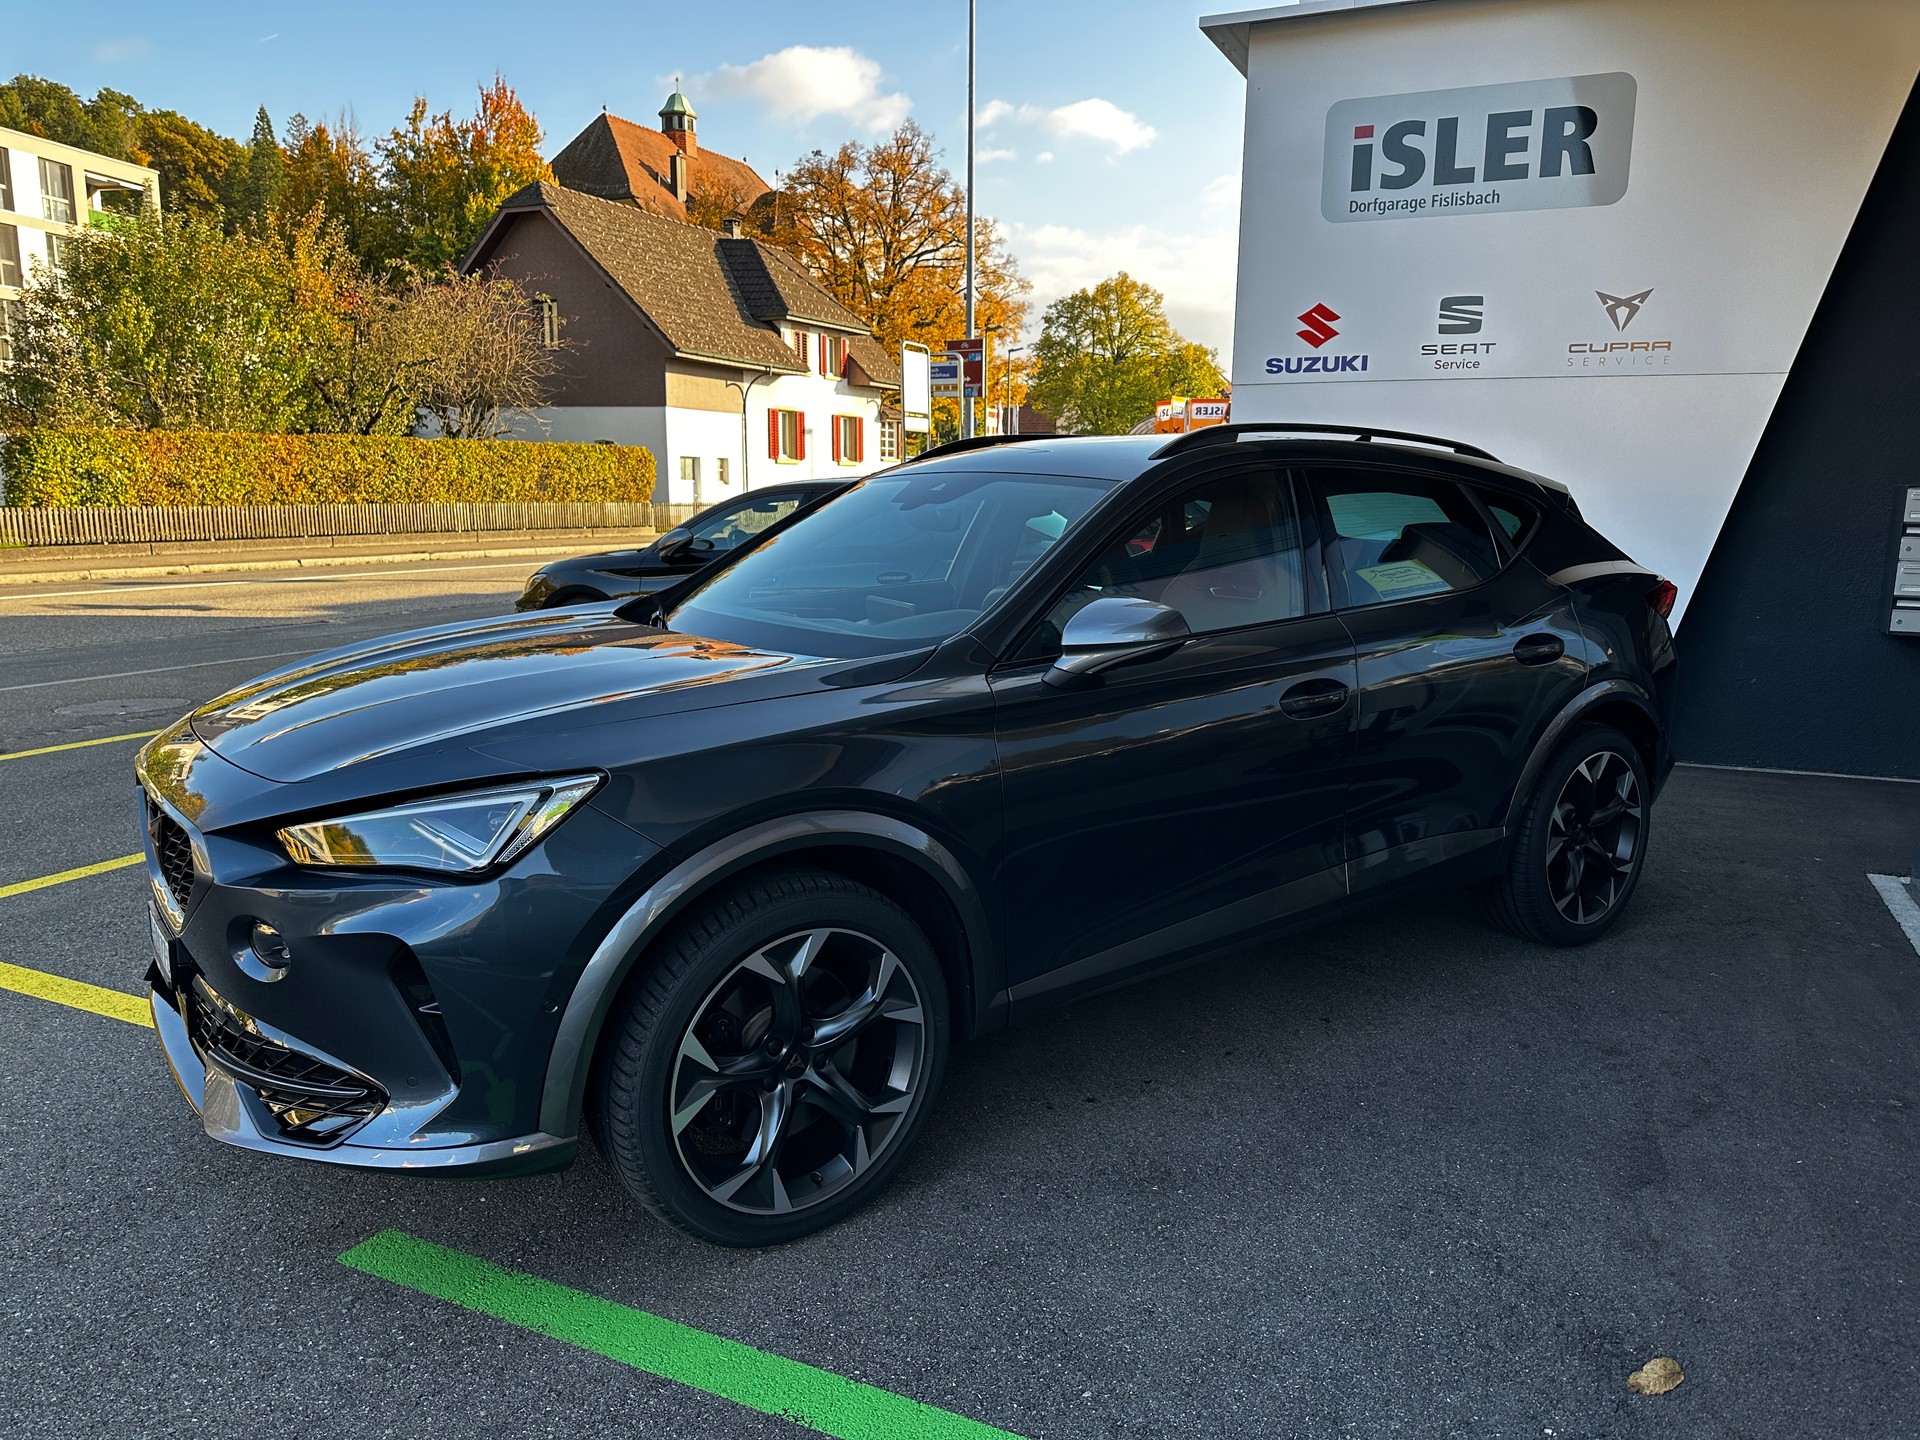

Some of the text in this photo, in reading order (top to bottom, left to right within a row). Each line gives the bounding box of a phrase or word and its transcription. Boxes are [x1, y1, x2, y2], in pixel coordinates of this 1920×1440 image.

[1350, 105, 1598, 192] iSLER
[1349, 190, 1501, 215] Dorfgarage Fislisbach
[1421, 342, 1497, 356] SEAT
[1568, 340, 1672, 354] CUPRA
[1265, 354, 1368, 374] SUZUKI
[1434, 359, 1480, 369] Service
[1567, 355, 1671, 367] SERVICE
